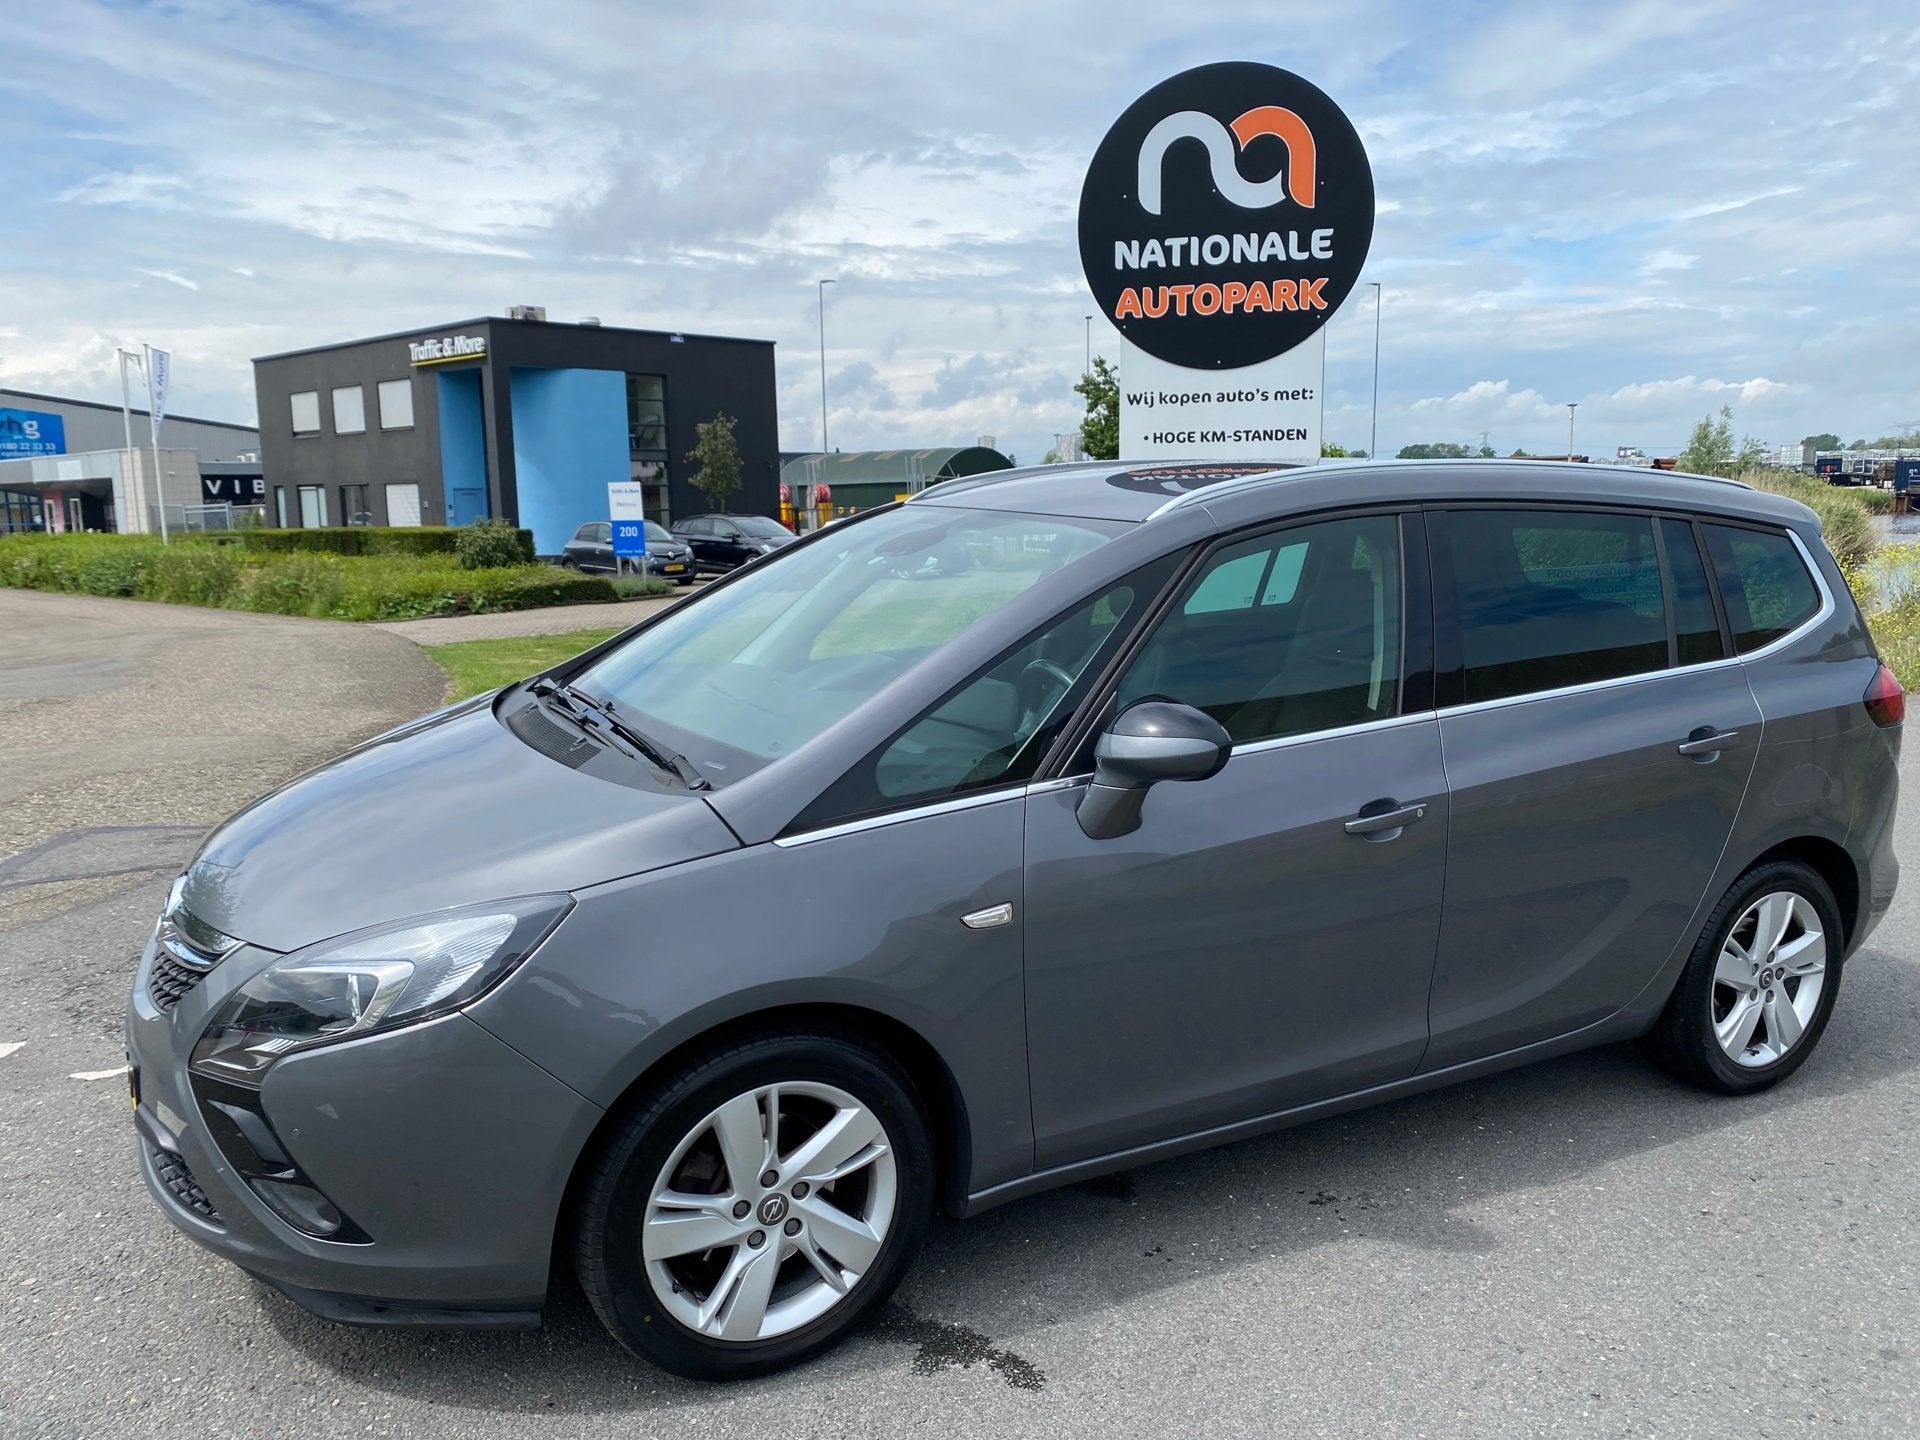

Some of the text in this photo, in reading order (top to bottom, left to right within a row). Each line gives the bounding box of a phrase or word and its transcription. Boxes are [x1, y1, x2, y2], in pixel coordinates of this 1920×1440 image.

[1114, 228, 1334, 270] NATIONALE
[1115, 277, 1330, 319] AUTOPARK
[408, 335, 486, 362] Traffic & More
[1127, 387, 1314, 408] Wij kopen auto's met:
[1152, 428, 1308, 444] HOGE KM-STANDEN
[619, 526, 638, 537] 200
